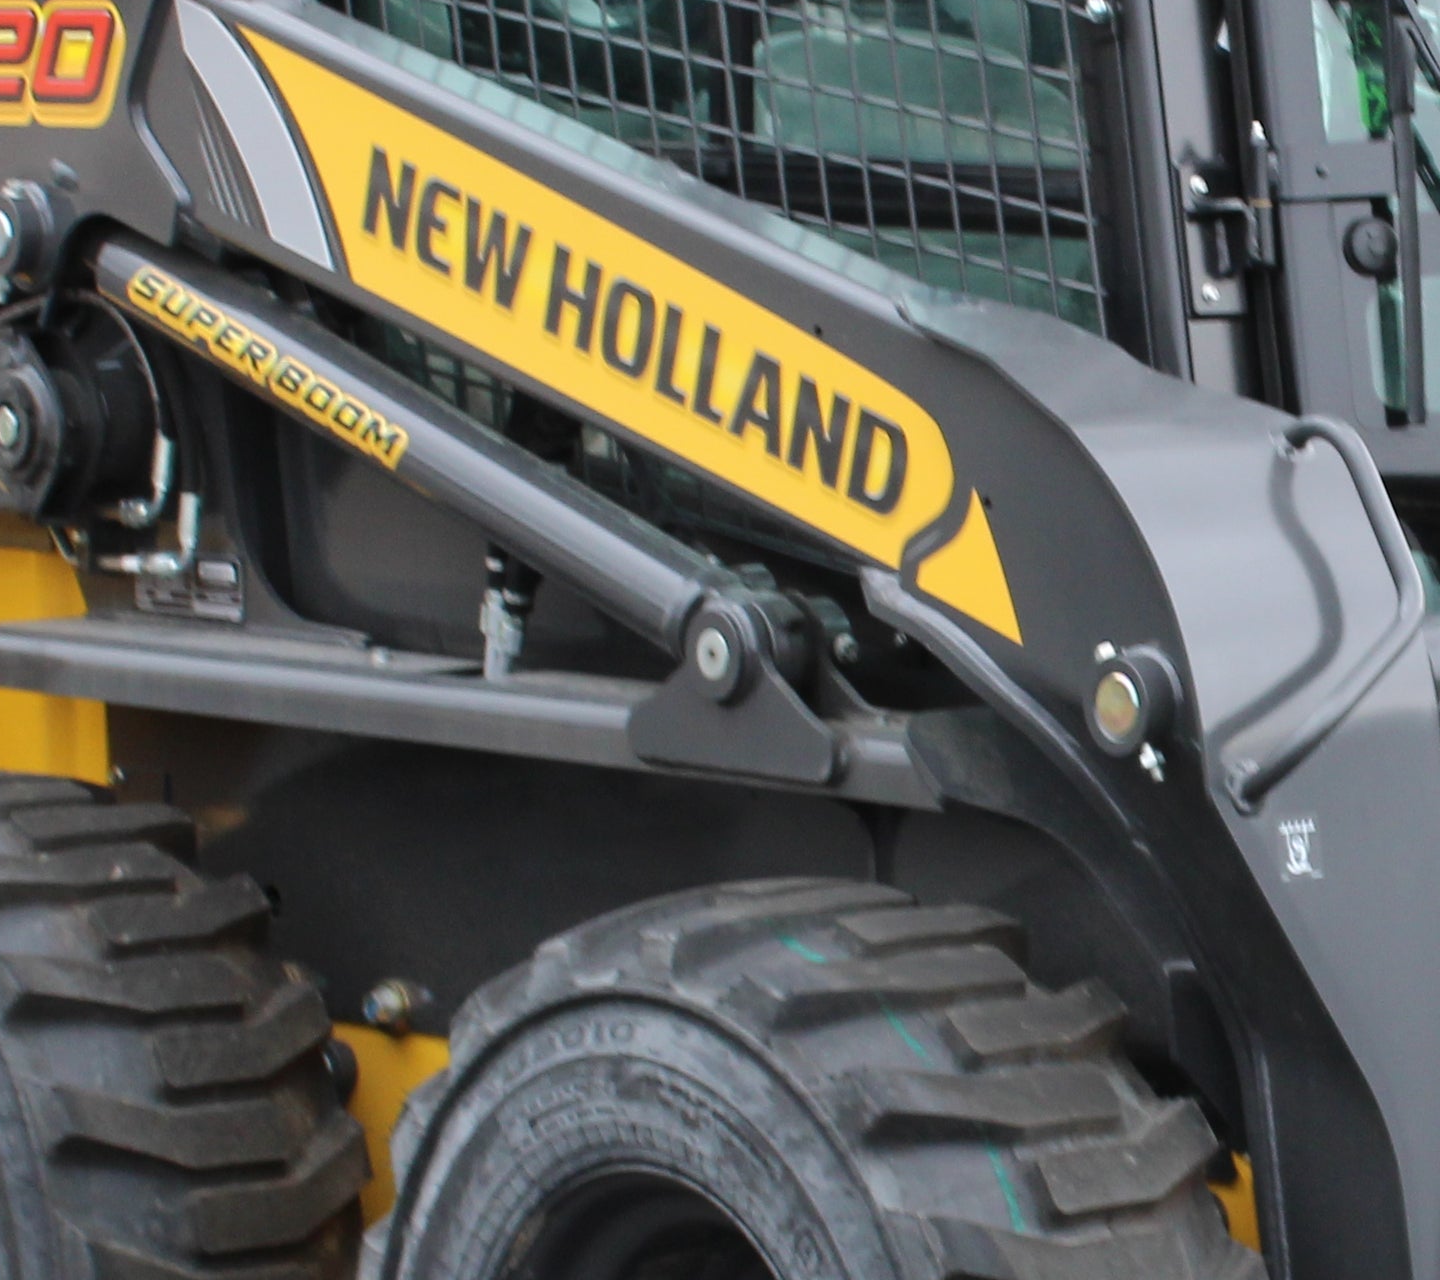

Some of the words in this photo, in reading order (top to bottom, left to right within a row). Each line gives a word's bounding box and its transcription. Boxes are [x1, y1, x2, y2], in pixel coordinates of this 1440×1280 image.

[129, 269, 272, 384] SUPER
[272, 356, 408, 462] BOOM
[362, 145, 532, 310] NEW
[544, 243, 909, 516] HOLLAND
